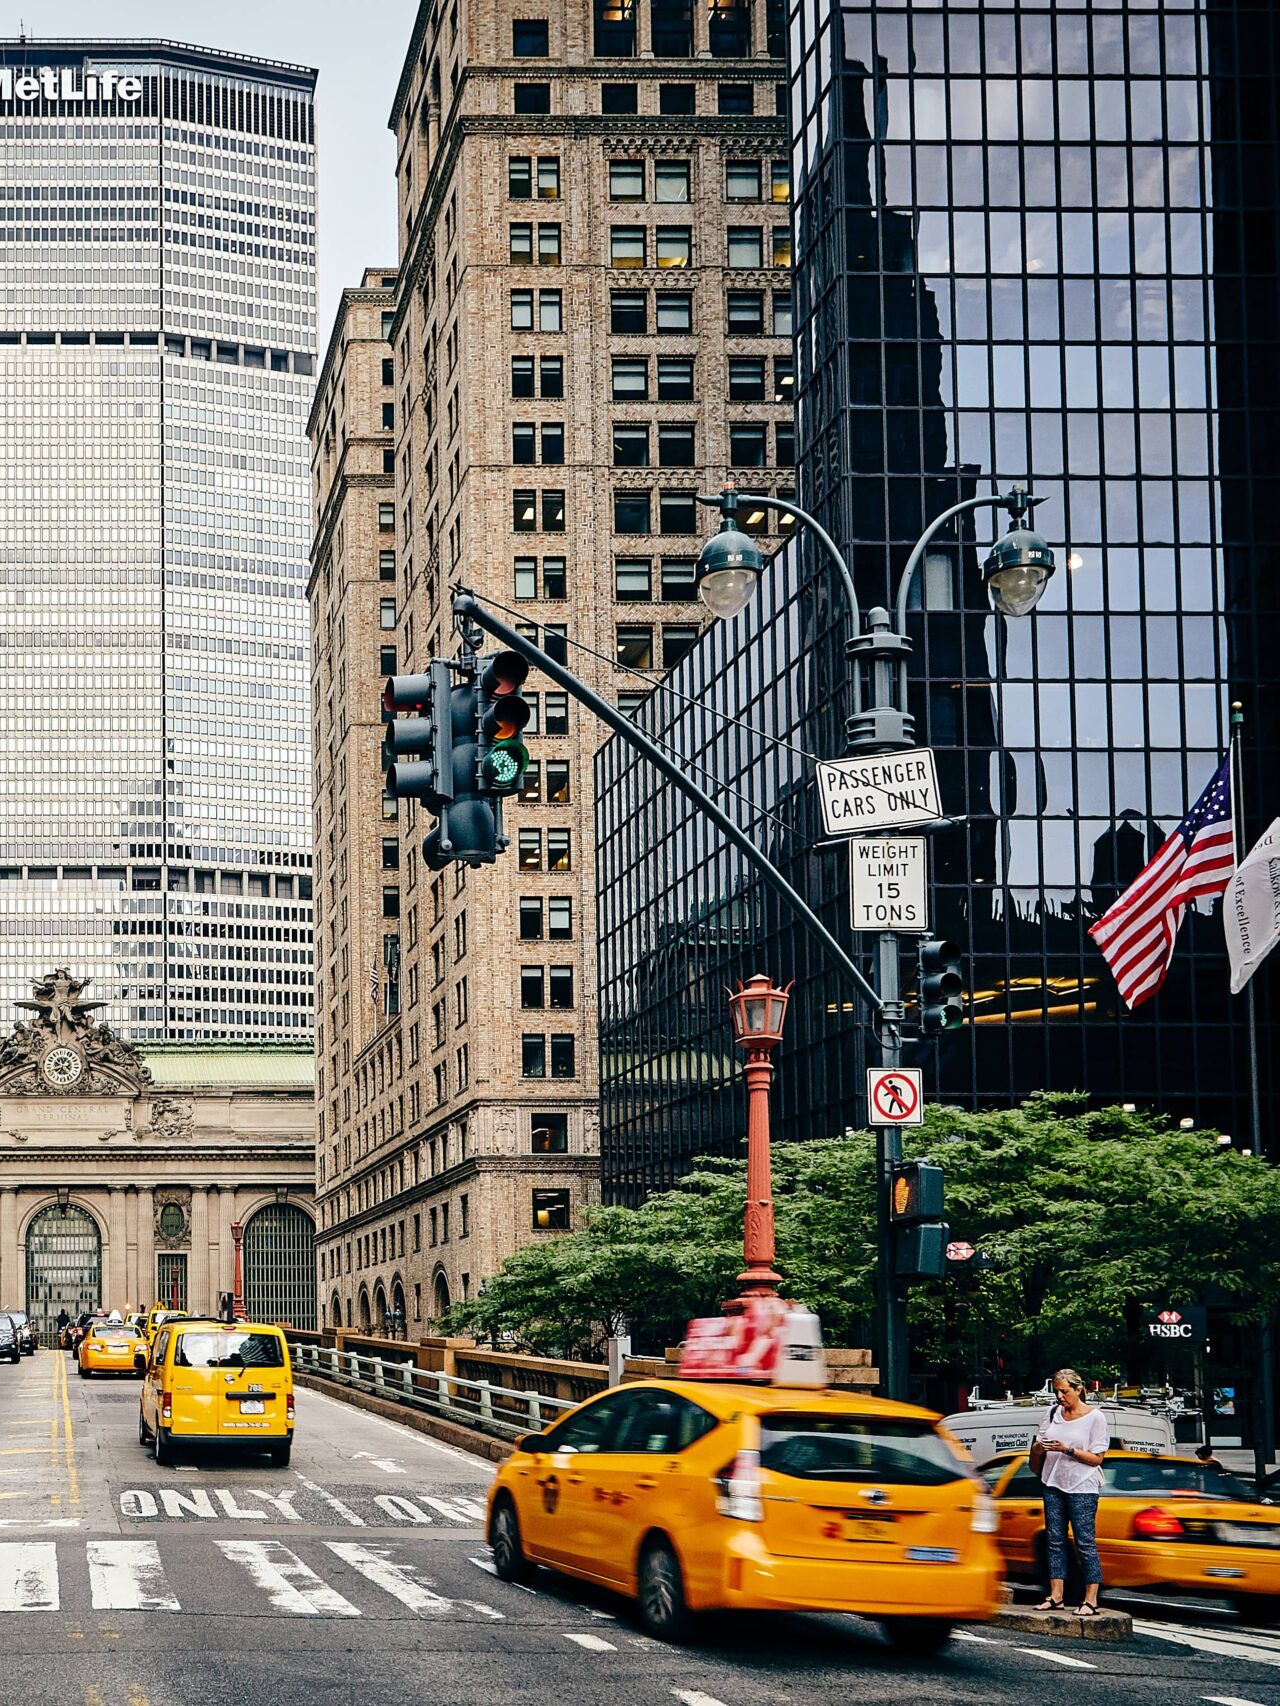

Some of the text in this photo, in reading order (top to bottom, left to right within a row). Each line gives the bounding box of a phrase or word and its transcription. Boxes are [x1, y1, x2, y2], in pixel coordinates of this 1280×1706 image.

[827, 761, 927, 792] PASSENGER
[831, 788, 929, 819] CARS ONLY
[858, 845, 918, 859] WEIGHT
[867, 863, 909, 877] LIMIT
[877, 882, 901, 899] 15
[862, 904, 917, 921] TONS
[1235, 876, 1251, 954] of Excellence
[16, 1104, 108, 1114] GRAND CENTRAL
[1148, 1324, 1192, 1338] HSBC
[120, 1489, 303, 1520] ONLY
